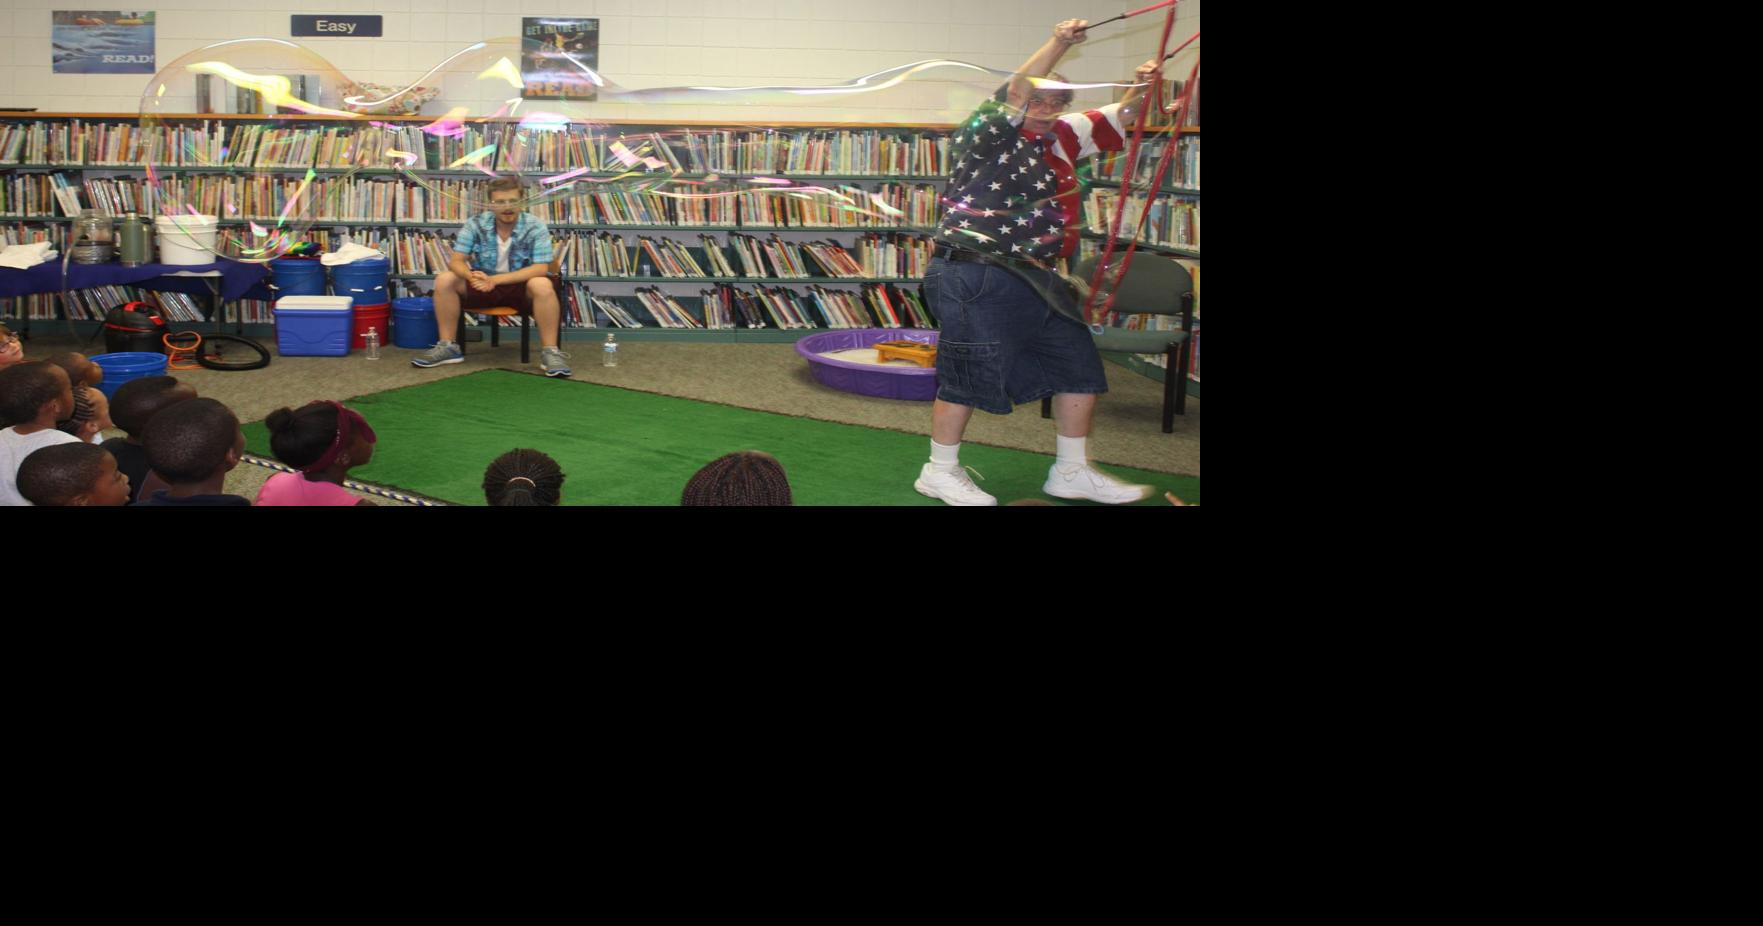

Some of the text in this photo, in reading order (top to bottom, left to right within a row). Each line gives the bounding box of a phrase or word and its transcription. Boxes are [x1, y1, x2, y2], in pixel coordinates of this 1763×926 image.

[316, 20, 357, 34] Easy
[526, 26, 541, 35] GET
[544, 25, 556, 34] IN
[102, 54, 154, 64] READ!
[525, 82, 593, 97] READ
